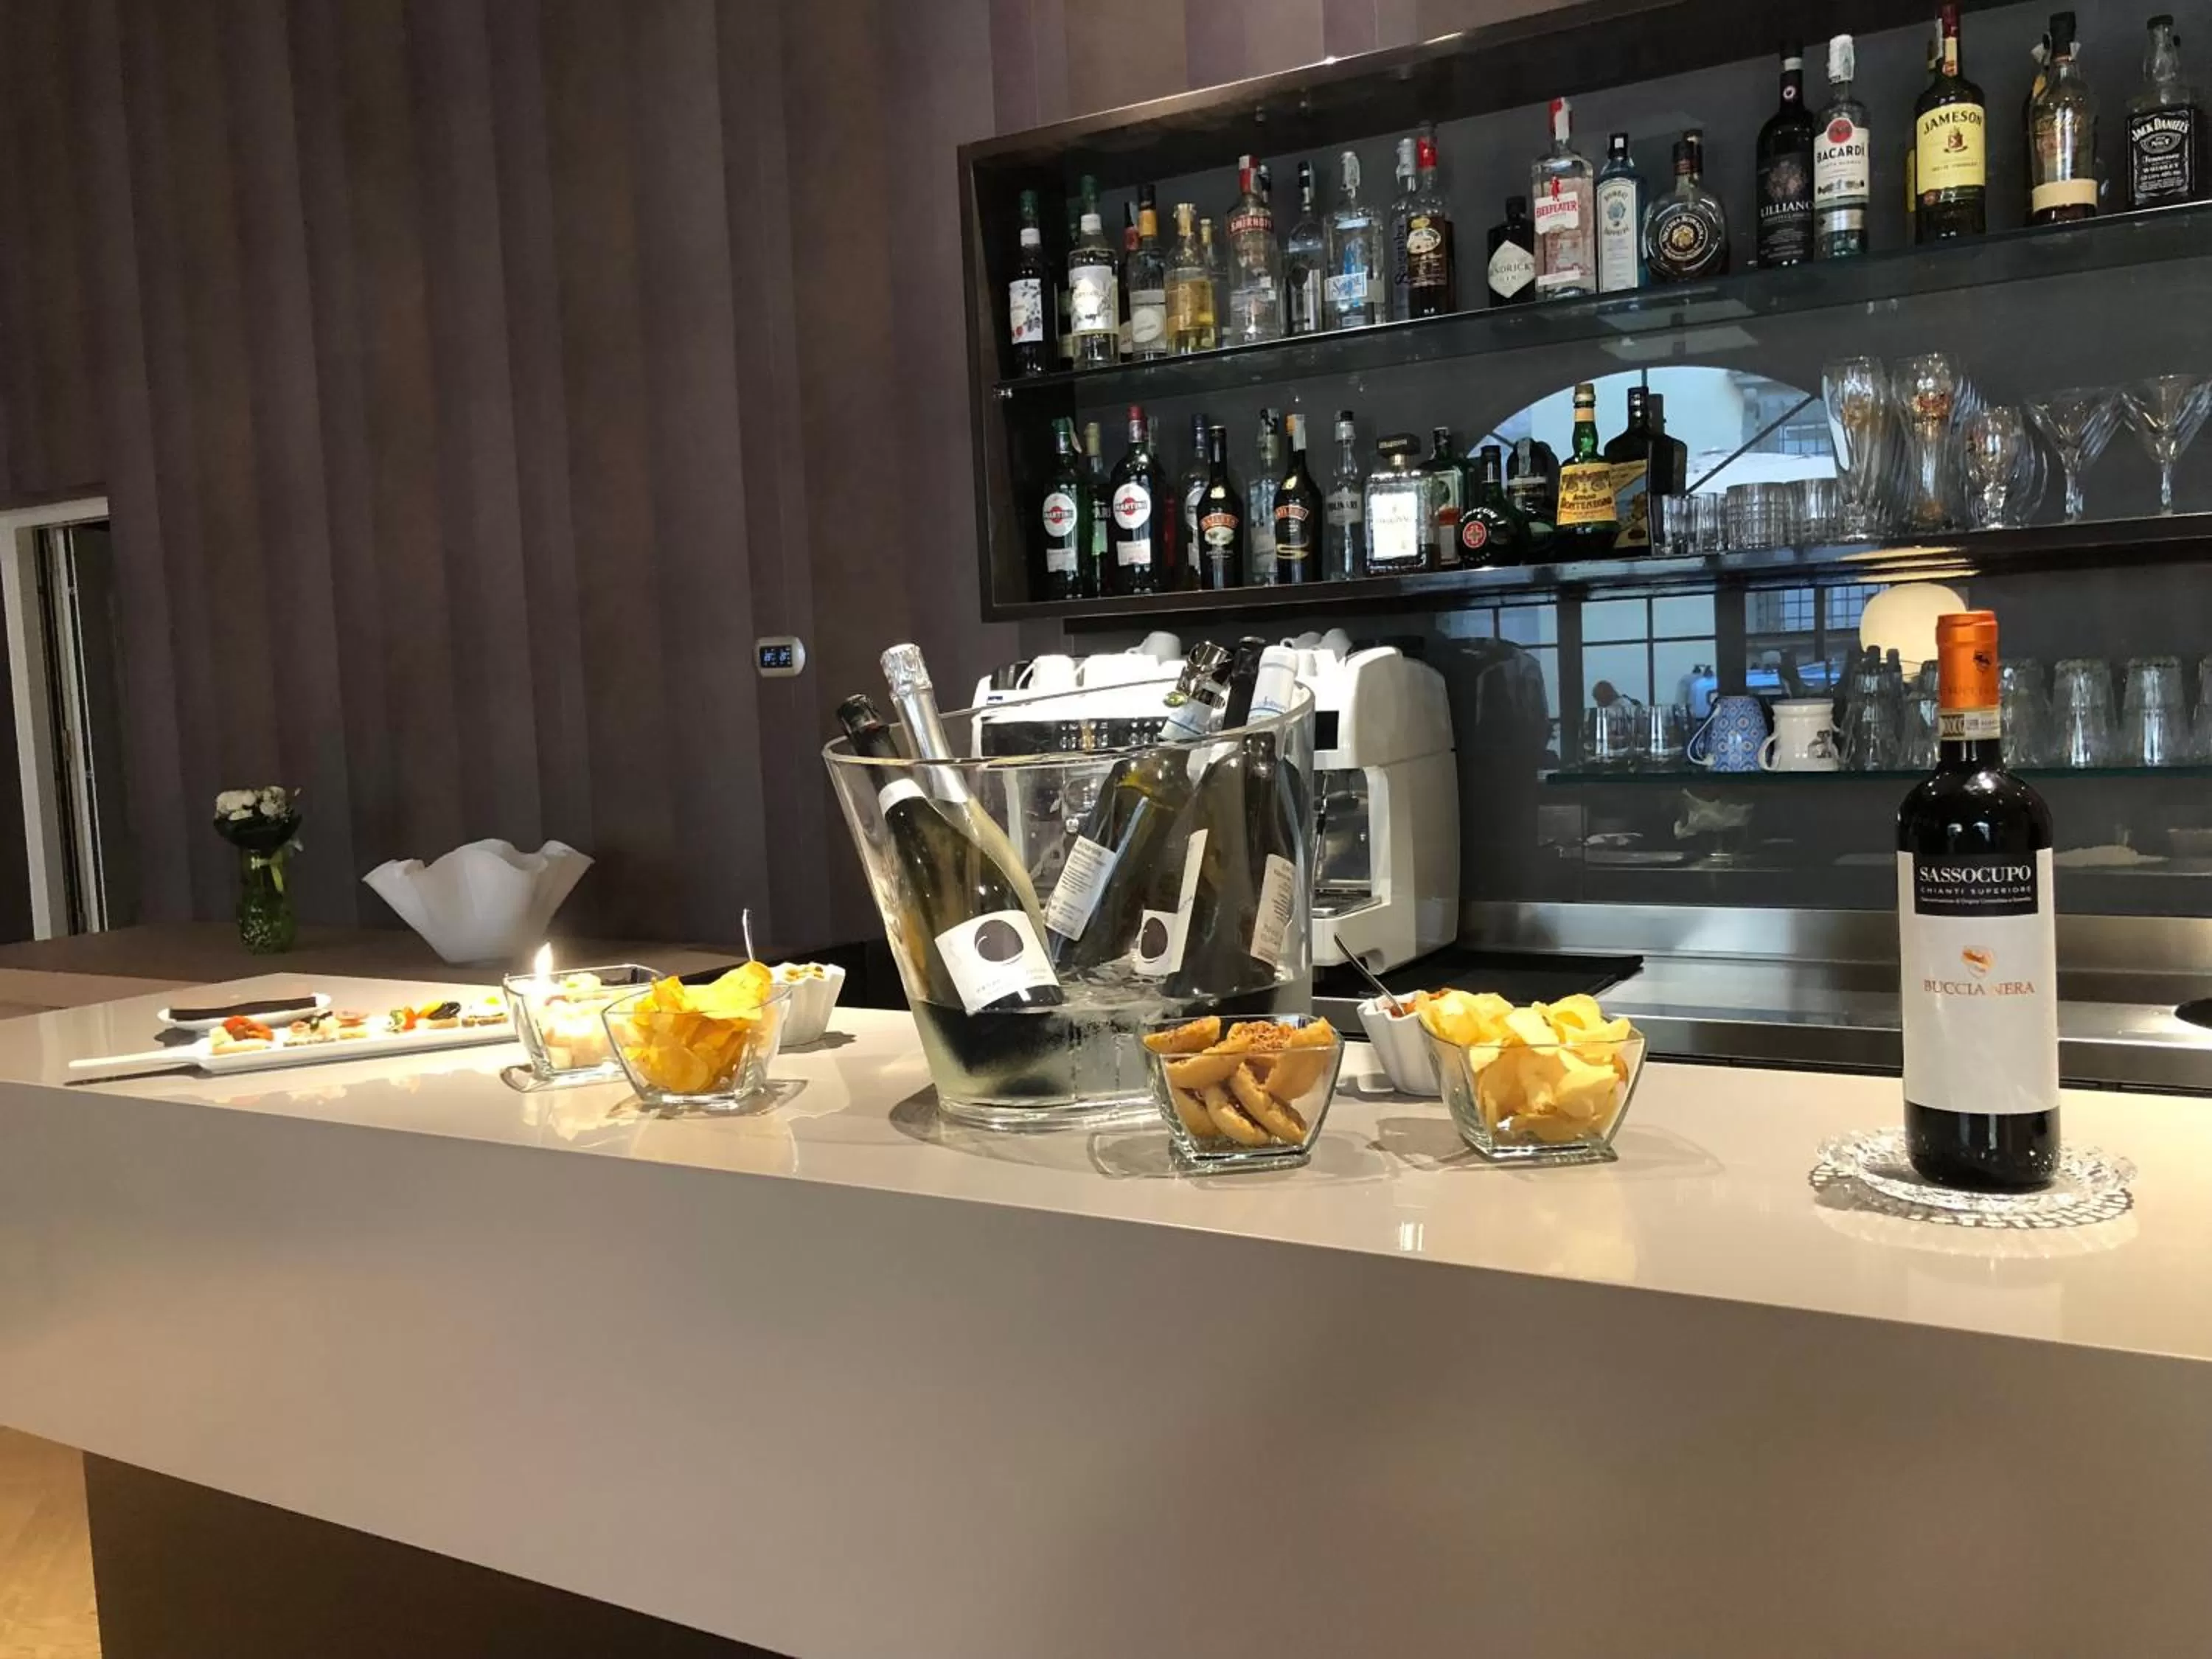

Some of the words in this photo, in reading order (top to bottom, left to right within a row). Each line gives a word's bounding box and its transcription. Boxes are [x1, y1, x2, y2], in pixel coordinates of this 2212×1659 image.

[1924, 110, 1982, 135] JAMESON
[2132, 122, 2153, 142] JACK
[1536, 199, 1578, 219] BEEFEATER
[1919, 865, 2031, 883] SASSOCUPO
[1920, 886, 1964, 894] CHIANTI
[1970, 885, 2031, 895] SUPERIORE
[1923, 979, 1986, 995] BUCCIA
